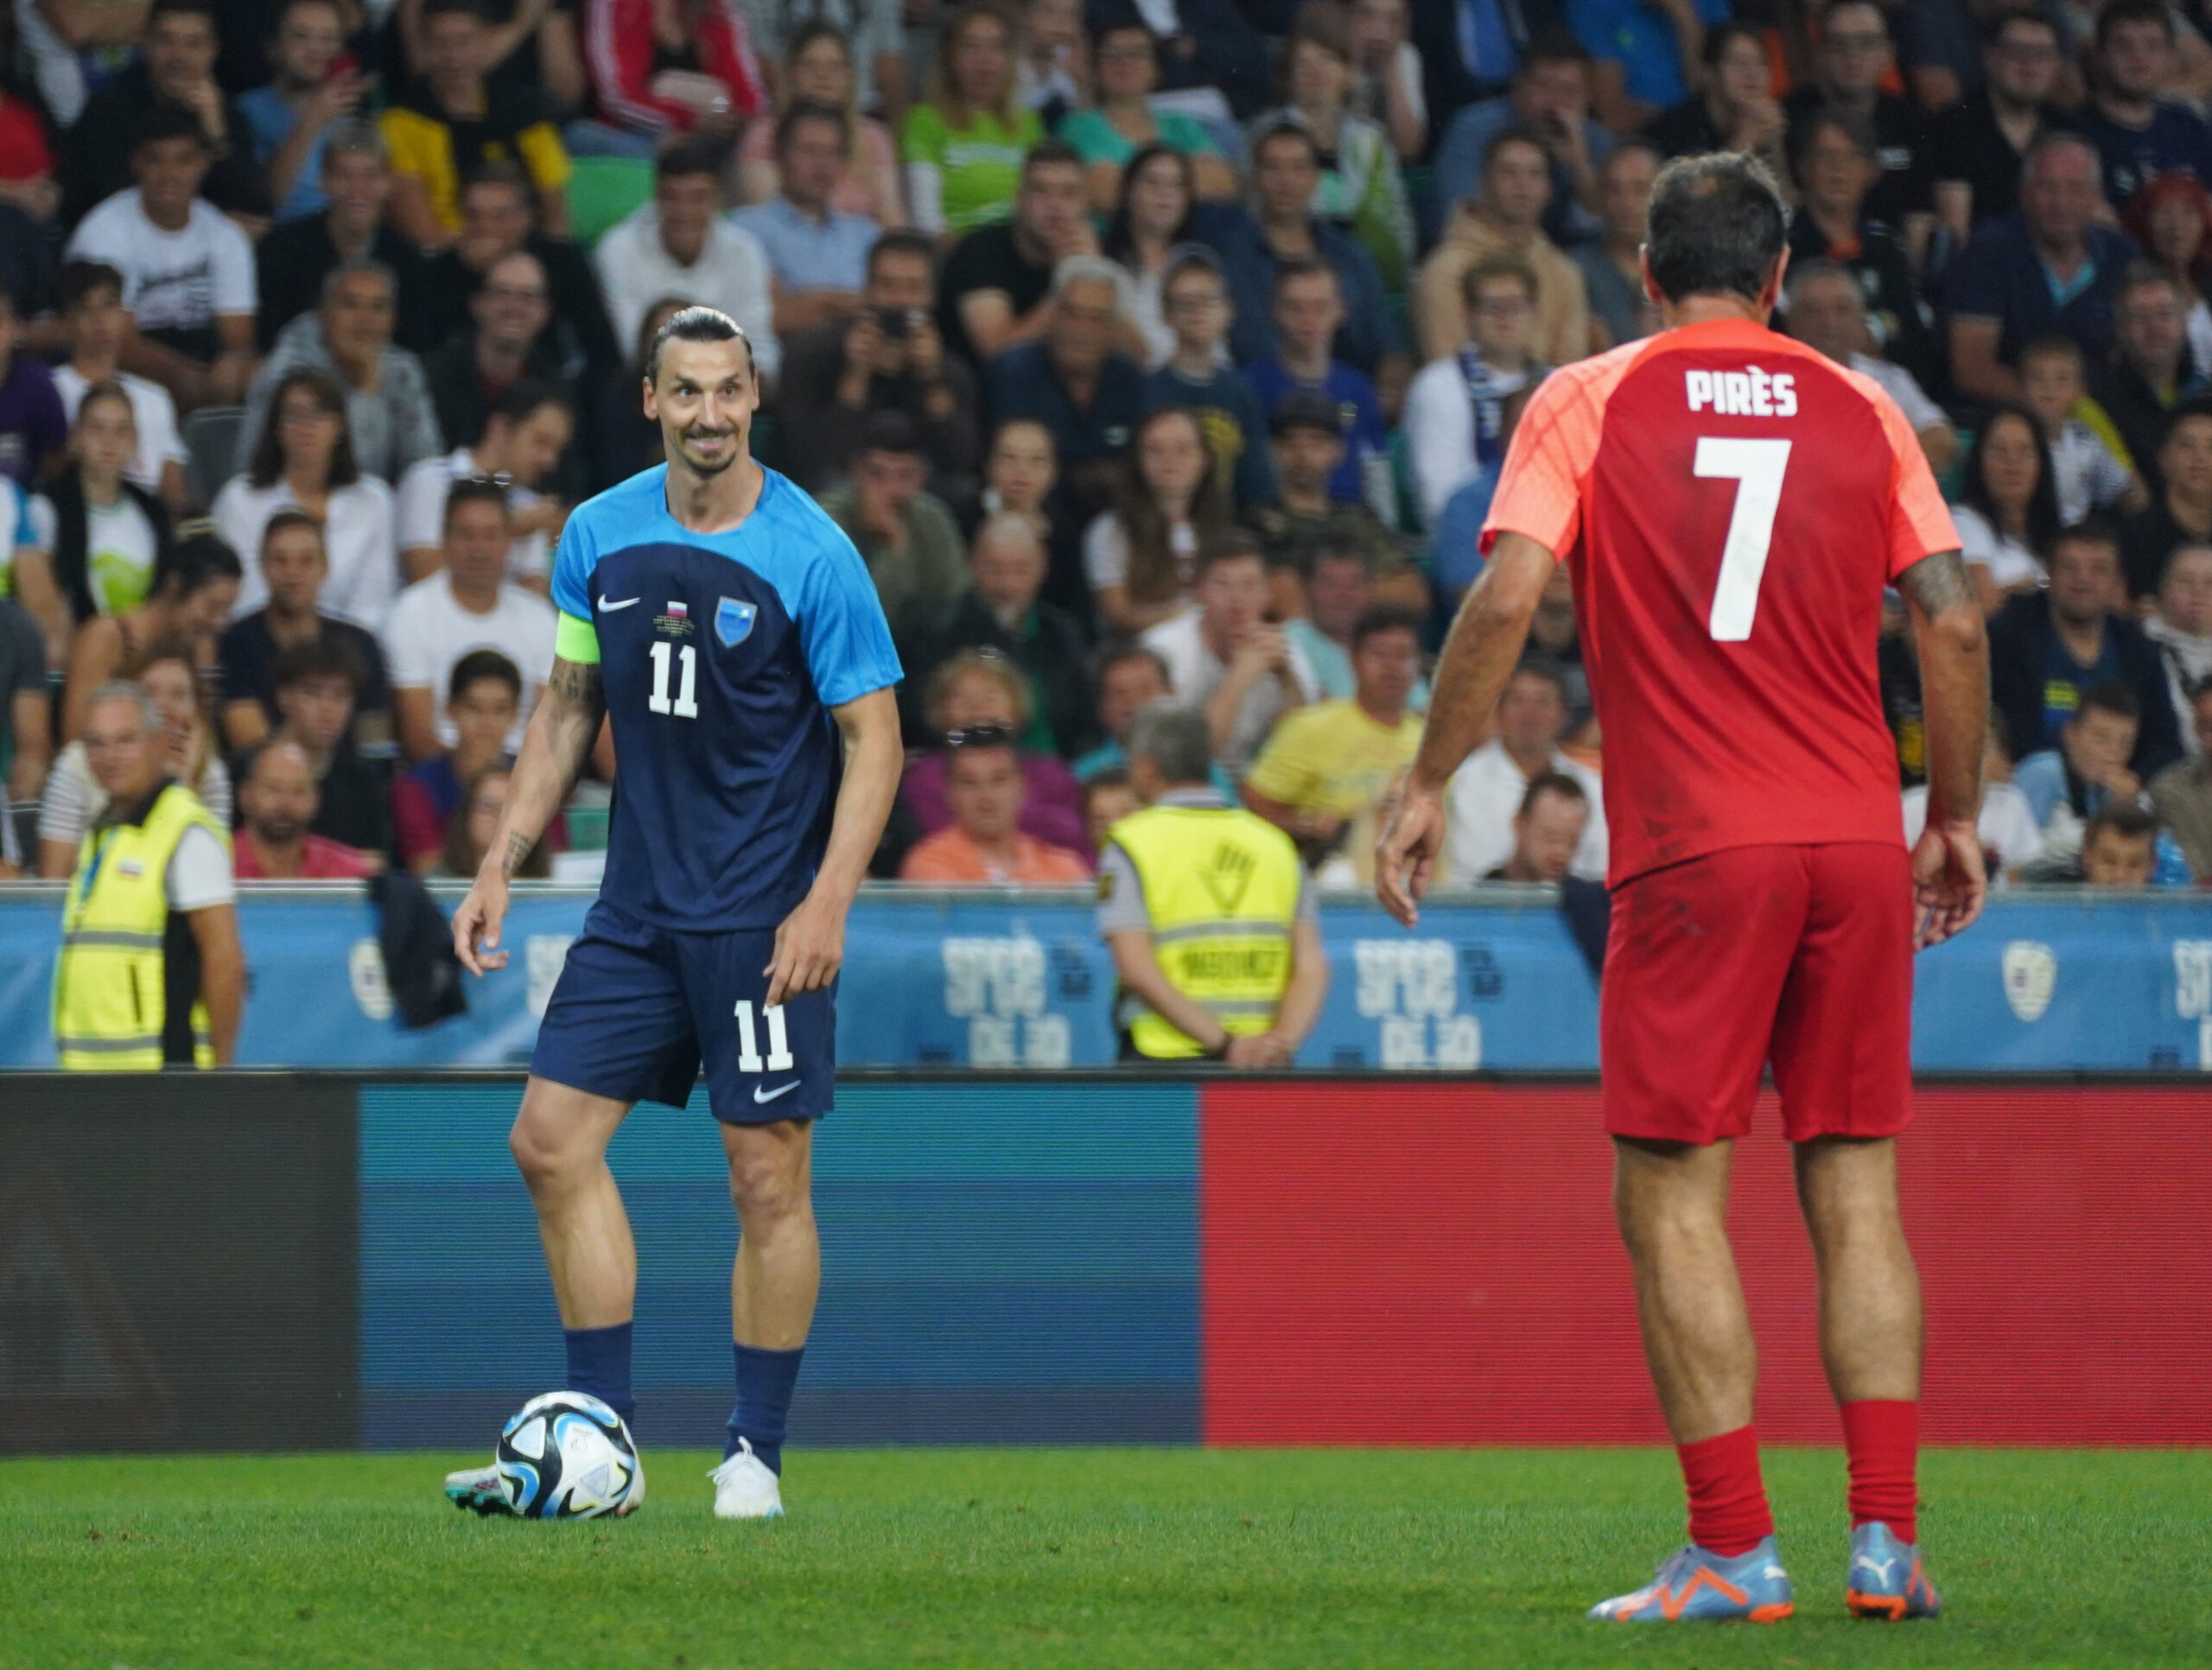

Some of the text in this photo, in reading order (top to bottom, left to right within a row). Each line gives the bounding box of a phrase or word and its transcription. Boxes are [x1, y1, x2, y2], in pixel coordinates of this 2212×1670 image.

[1685, 365, 1798, 417] PIRÈS
[1694, 436, 1793, 641] 7
[649, 641, 698, 718] 11
[734, 1000, 793, 1072] 11
